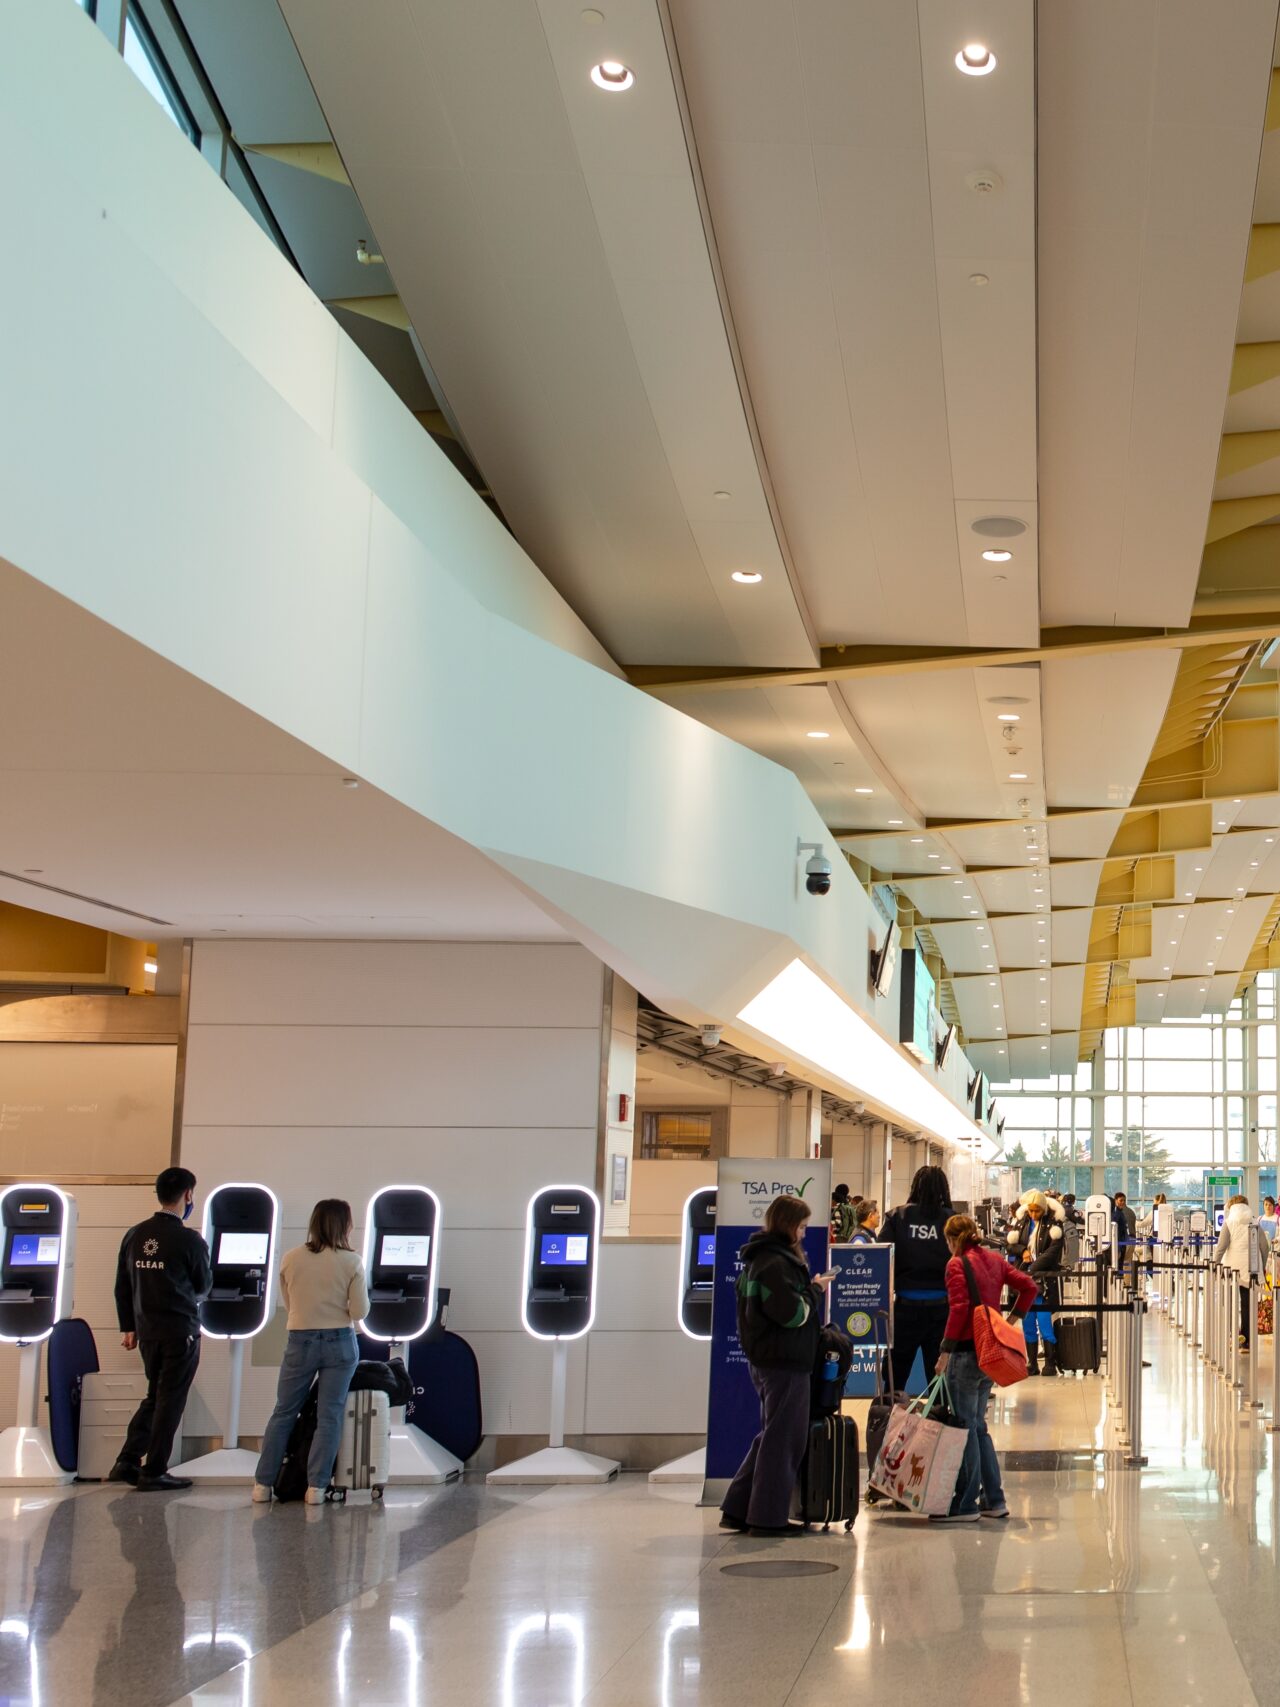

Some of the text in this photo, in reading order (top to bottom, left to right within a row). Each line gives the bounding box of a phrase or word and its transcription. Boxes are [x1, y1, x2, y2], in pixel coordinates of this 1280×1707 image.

[742, 1182, 794, 1194] TSA Pre
[909, 1224, 938, 1240] TSA
[136, 1260, 164, 1270] CLEAR
